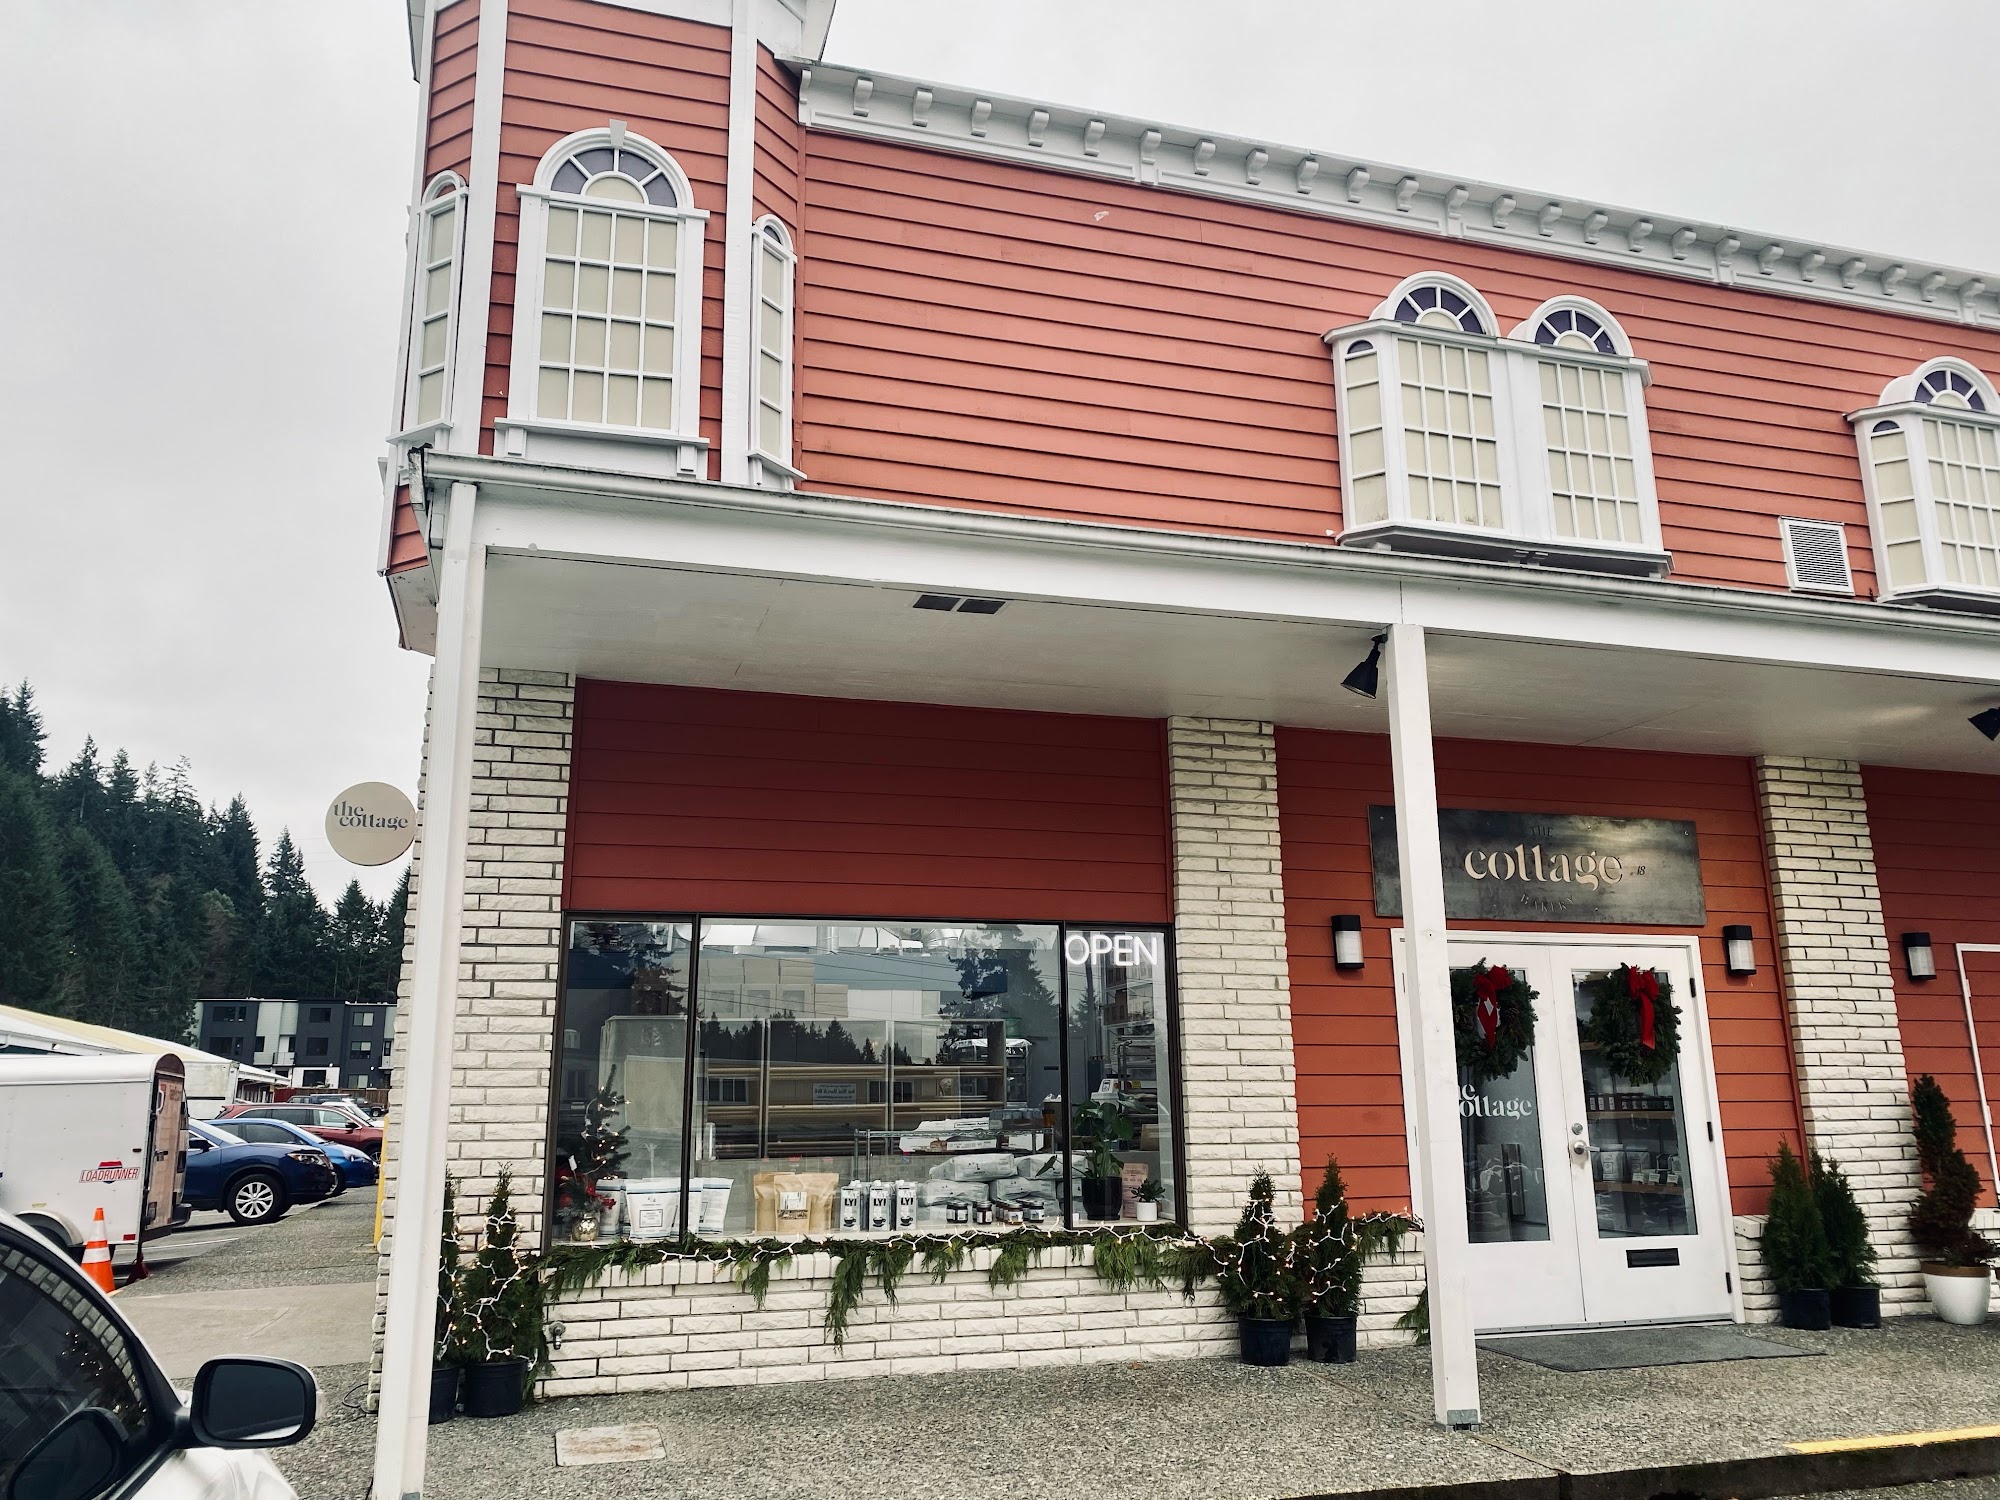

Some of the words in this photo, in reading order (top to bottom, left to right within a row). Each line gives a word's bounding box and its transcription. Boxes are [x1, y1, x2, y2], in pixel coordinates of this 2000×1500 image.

[334, 800, 364, 817] the
[339, 814, 408, 831] cottage
[1464, 843, 1623, 891] cottage
[1065, 934, 1158, 966] OPEN
[1459, 1095, 1533, 1120] ottage
[80, 1168, 139, 1182] LOADRUNNER
